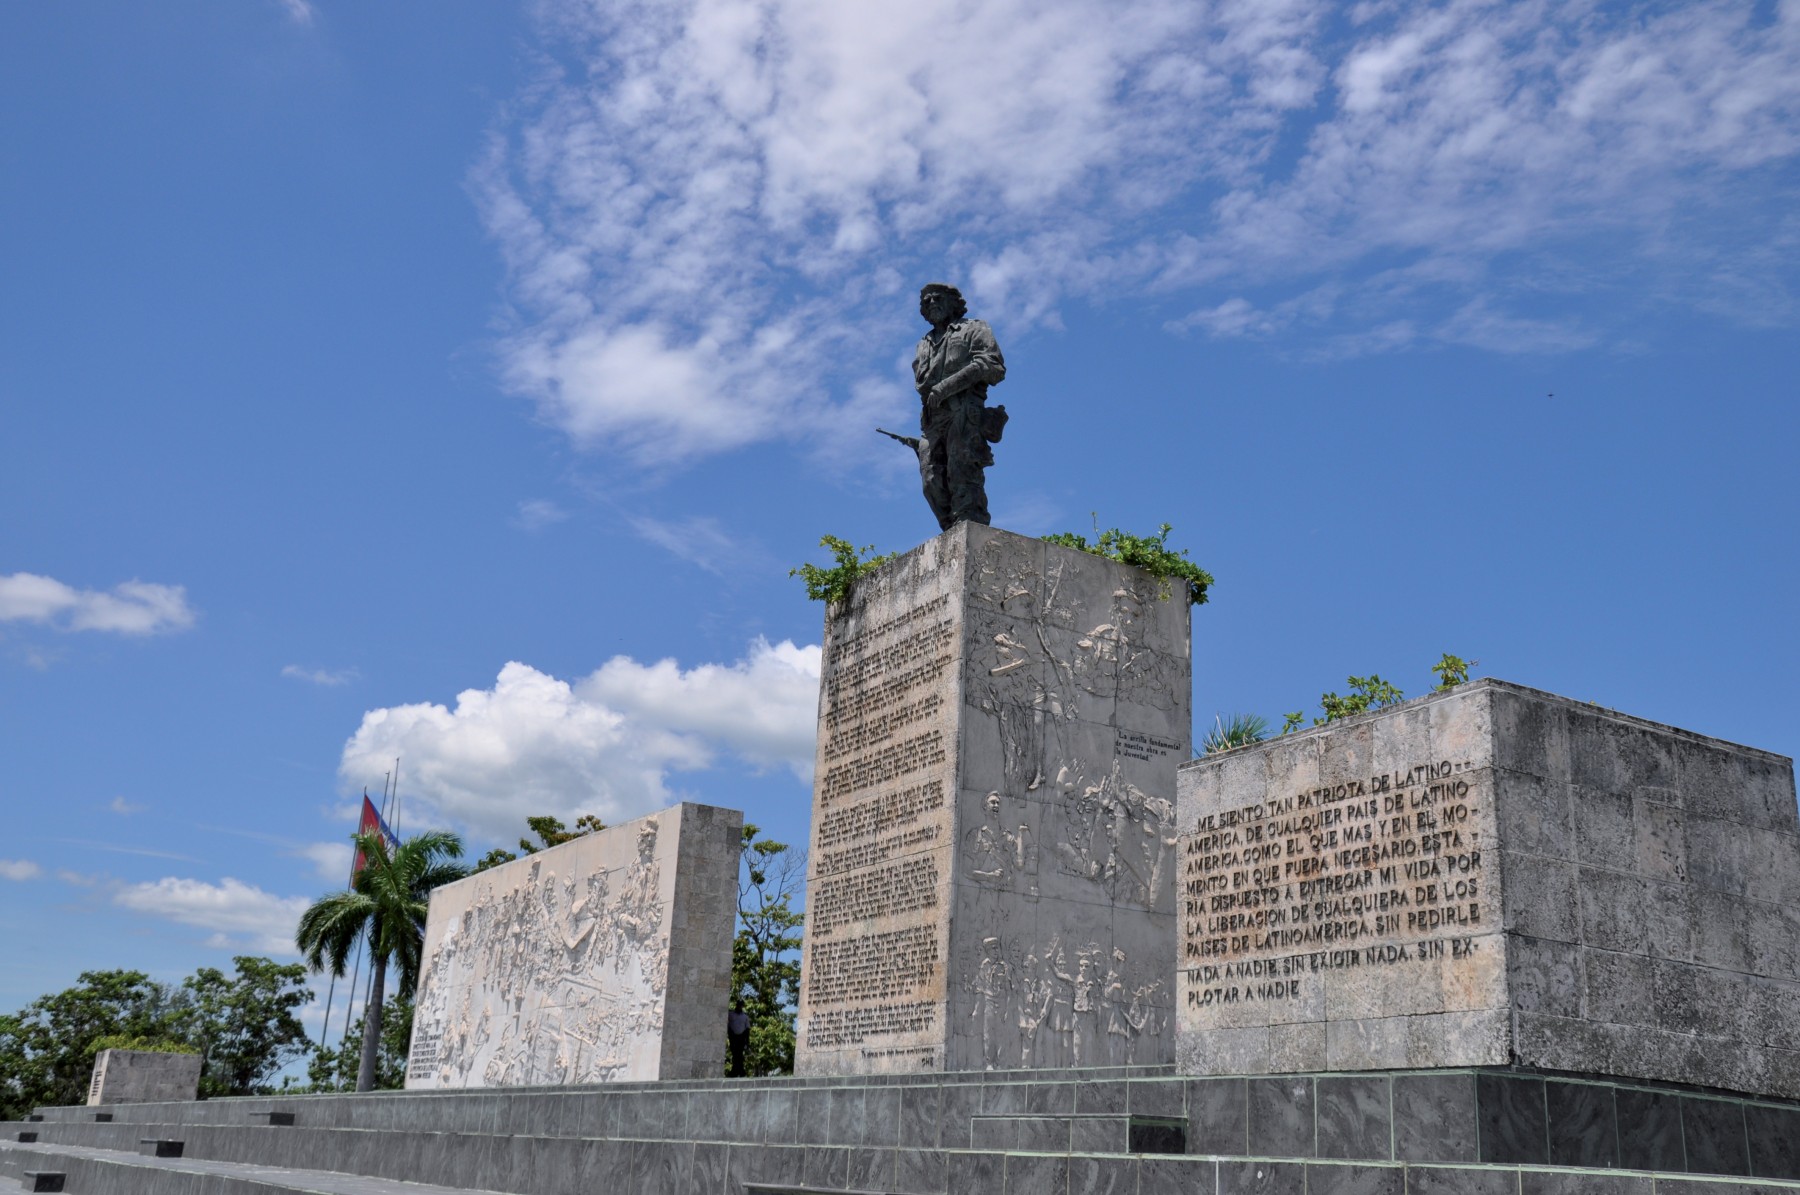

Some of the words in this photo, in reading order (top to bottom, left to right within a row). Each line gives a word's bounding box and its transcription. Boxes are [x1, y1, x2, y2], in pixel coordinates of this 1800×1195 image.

[1149, 738, 1181, 750] fundamental
[1187, 831, 1243, 856] AMERICA,
[1246, 825, 1263, 843] DE
[1267, 807, 1342, 838] CUALQUIER
[1347, 800, 1378, 820] PAIS
[1384, 793, 1404, 814] DE
[1410, 780, 1469, 808] LATINO
[1197, 815, 1215, 833] ME
[1219, 804, 1264, 827] SIENTO
[1268, 797, 1293, 817] TAN
[1298, 781, 1366, 810] PATRIOTA
[1371, 774, 1390, 795] DE
[1243, 842, 1282, 865] COMO
[1286, 837, 1304, 856] EL
[1310, 830, 1338, 853] QUE
[1343, 824, 1373, 845] MAS
[1391, 815, 1411, 834] EN
[1416, 810, 1437, 830] EL
[1186, 874, 1228, 897] MENTO
[1233, 869, 1249, 888] EN
[1253, 865, 1280, 886] QUE
[1285, 856, 1329, 877] FUERA
[1334, 838, 1420, 868] NECESARIO,
[1186, 900, 1206, 917] RIA
[1211, 886, 1279, 912] DISPUESTO
[1284, 884, 1294, 900] A
[1299, 870, 1373, 898] ENTREGAR
[1379, 865, 1397, 884] MI
[1403, 860, 1441, 879] VIDA
[1445, 851, 1481, 873] POR
[1186, 920, 1203, 937] LA
[1208, 908, 1286, 933] LIBERACION
[1291, 903, 1310, 922] DE
[1314, 888, 1410, 919] CUALQUIERA
[1415, 884, 1438, 904] DE
[1443, 878, 1478, 899] LOS
[1186, 937, 1228, 957] PAISES
[1231, 934, 1250, 952] DE
[1375, 913, 1400, 934] SIN
[1408, 903, 1481, 930] PEDIRLE
[1187, 965, 1220, 986] NADA
[1225, 961, 1235, 979] A
[1282, 955, 1305, 976] SIN
[1309, 949, 1361, 973] EXIGIR
[1417, 940, 1444, 960] SIN
[1188, 986, 1240, 1007] PLOTAR
[1245, 985, 1254, 1001] A
[1258, 980, 1300, 1000] NADIE
